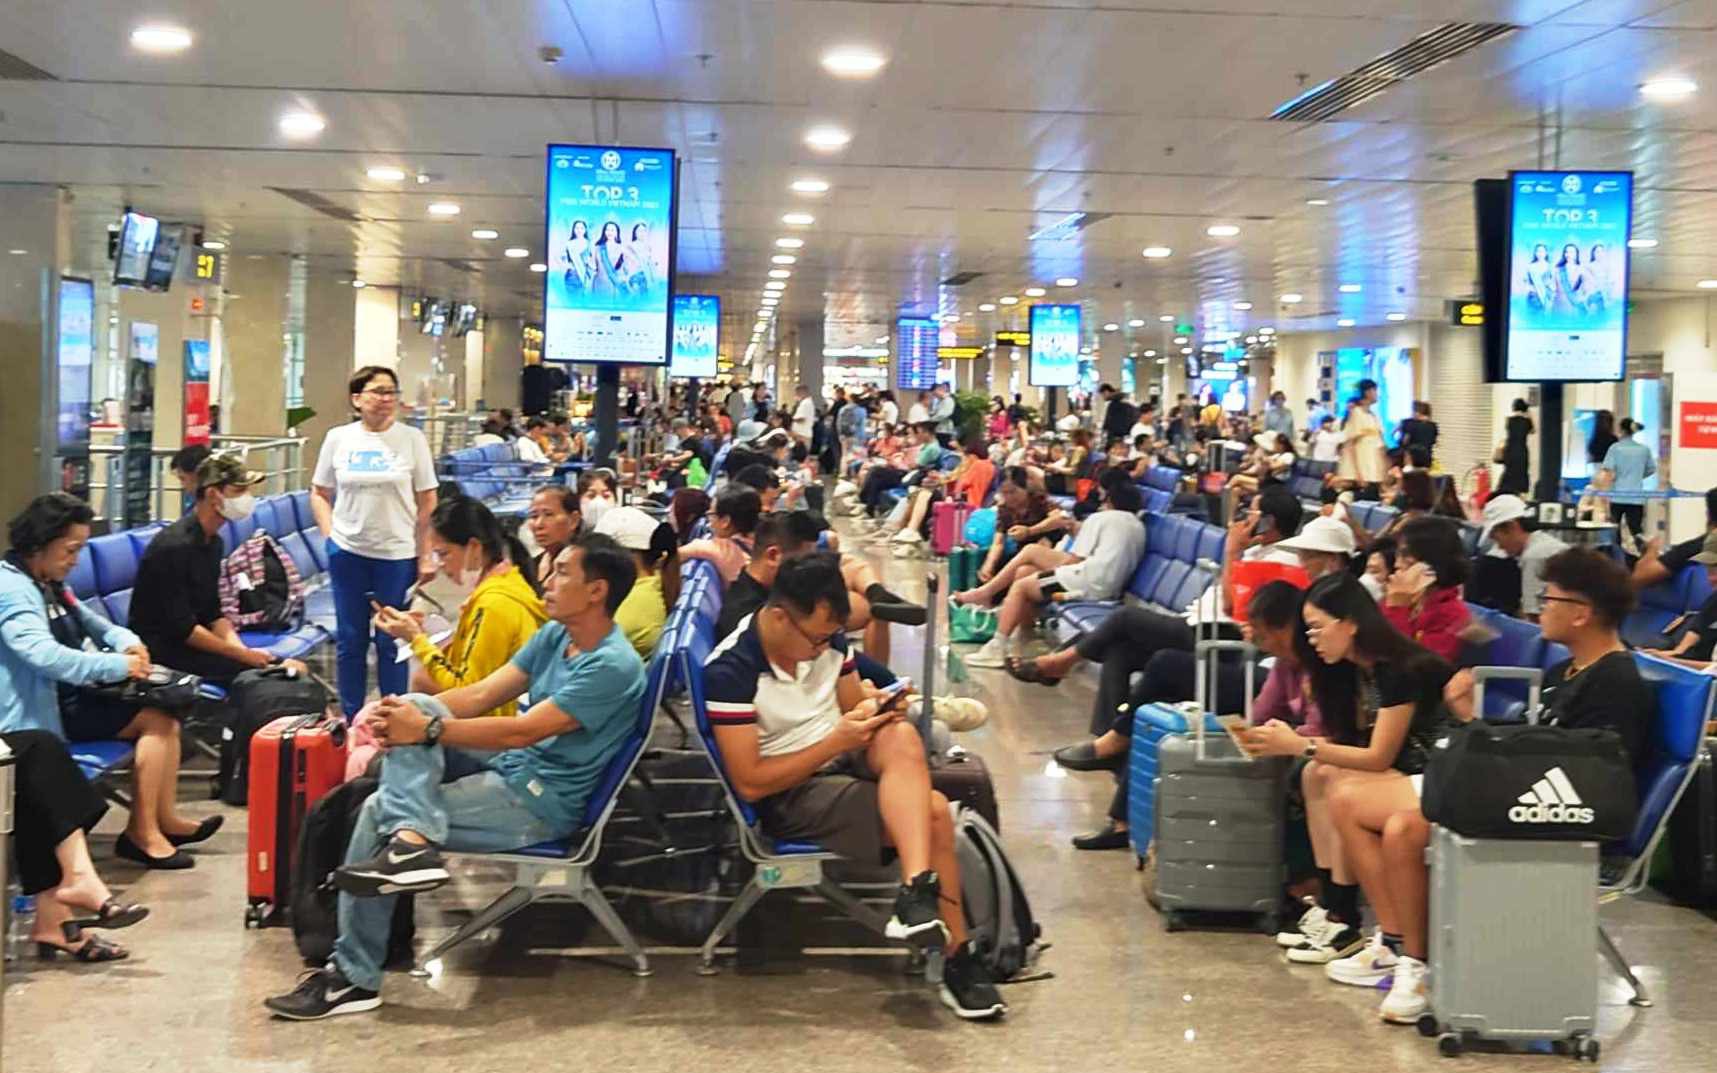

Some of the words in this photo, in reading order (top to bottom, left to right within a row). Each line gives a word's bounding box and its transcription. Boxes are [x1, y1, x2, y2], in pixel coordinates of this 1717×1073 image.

[581, 185, 624, 201] TOP
[627, 186, 640, 203] 3
[1542, 208, 1583, 222] TOP
[1587, 208, 1598, 224] 3
[1508, 800, 1595, 824] adidas
